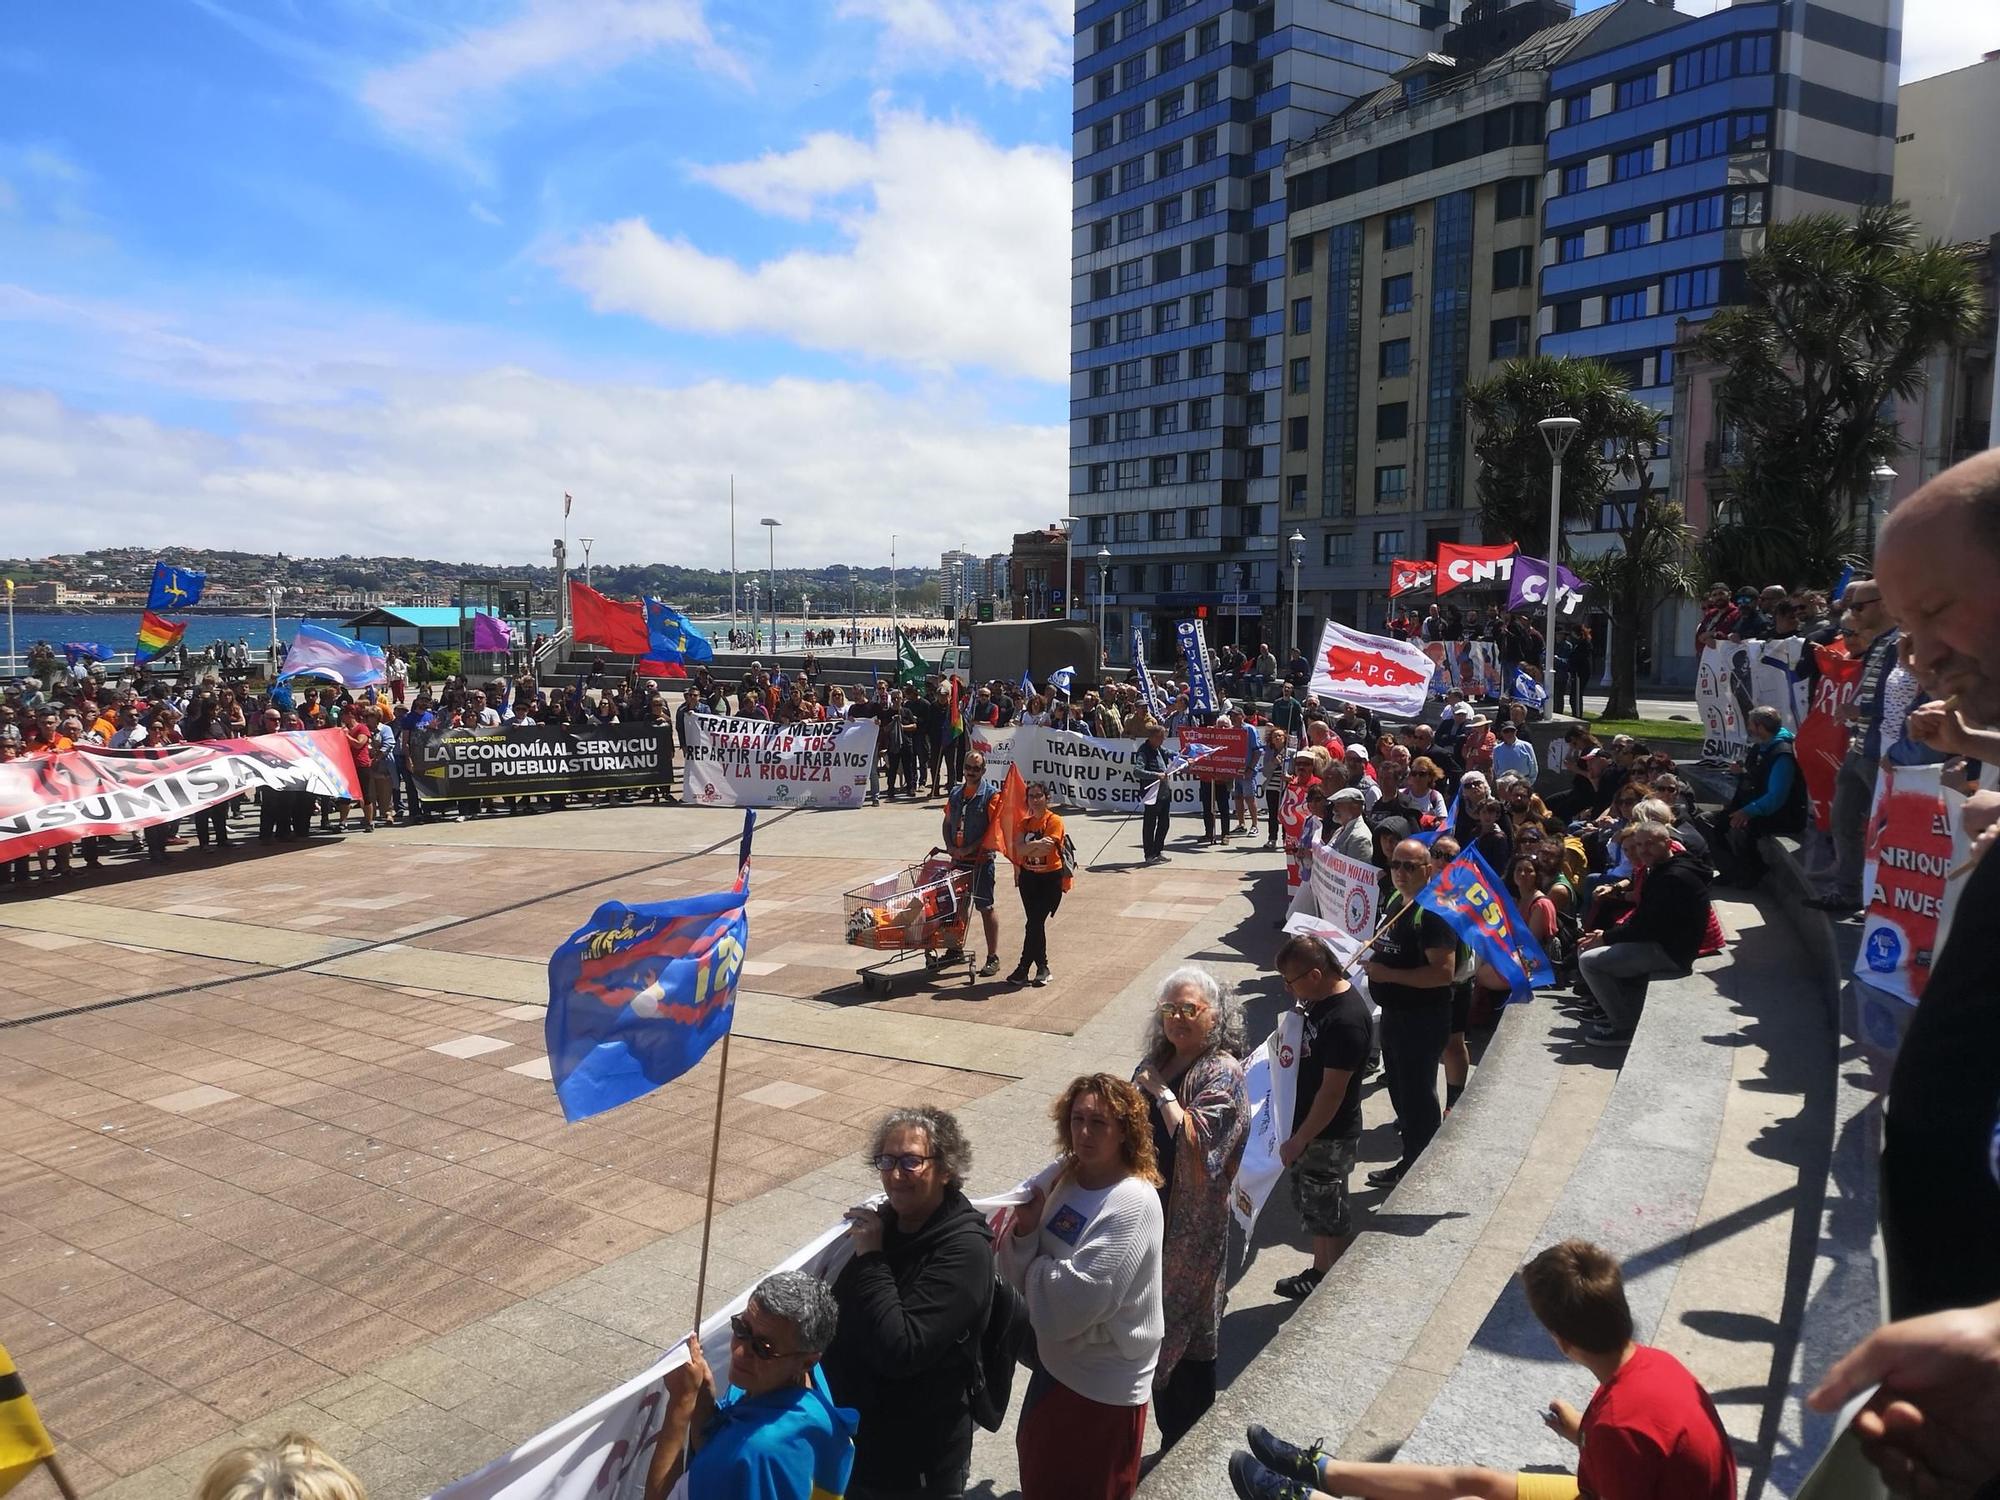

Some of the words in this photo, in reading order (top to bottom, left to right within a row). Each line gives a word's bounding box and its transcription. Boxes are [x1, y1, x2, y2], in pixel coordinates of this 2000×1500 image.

[1448, 557, 1514, 583] CNT
[1521, 575, 1584, 615] CNT
[699, 717, 781, 735] TRABAYAR
[788, 721, 845, 737] MENOS
[424, 746, 451, 762] LA
[455, 738, 551, 761] ECONOMÍA
[553, 742, 573, 757] AL
[576, 737, 658, 756] SERVICIU
[440, 737, 475, 745] VAMOS
[475, 735, 506, 743] PONER
[710, 732, 794, 753] TRABAYAR
[804, 735, 836, 752] TOES
[1046, 738, 1125, 764] TRABAYU
[449, 761, 488, 779] DEL
[491, 758, 557, 777] PUEBLU
[558, 753, 658, 775] ASTURIANU
[685, 745, 751, 765] REPARTIR
[755, 750, 782, 765] LOS
[794, 751, 868, 768] TRABAYOS
[721, 764, 730, 777] Y
[735, 763, 752, 779] LA
[759, 764, 832, 782] RIQUEZA
[1033, 759, 1100, 781] FUTURU
[1060, 780, 1077, 798] DE
[1079, 784, 1108, 801] LOS
[1347, 863, 1375, 887] MOLINA
